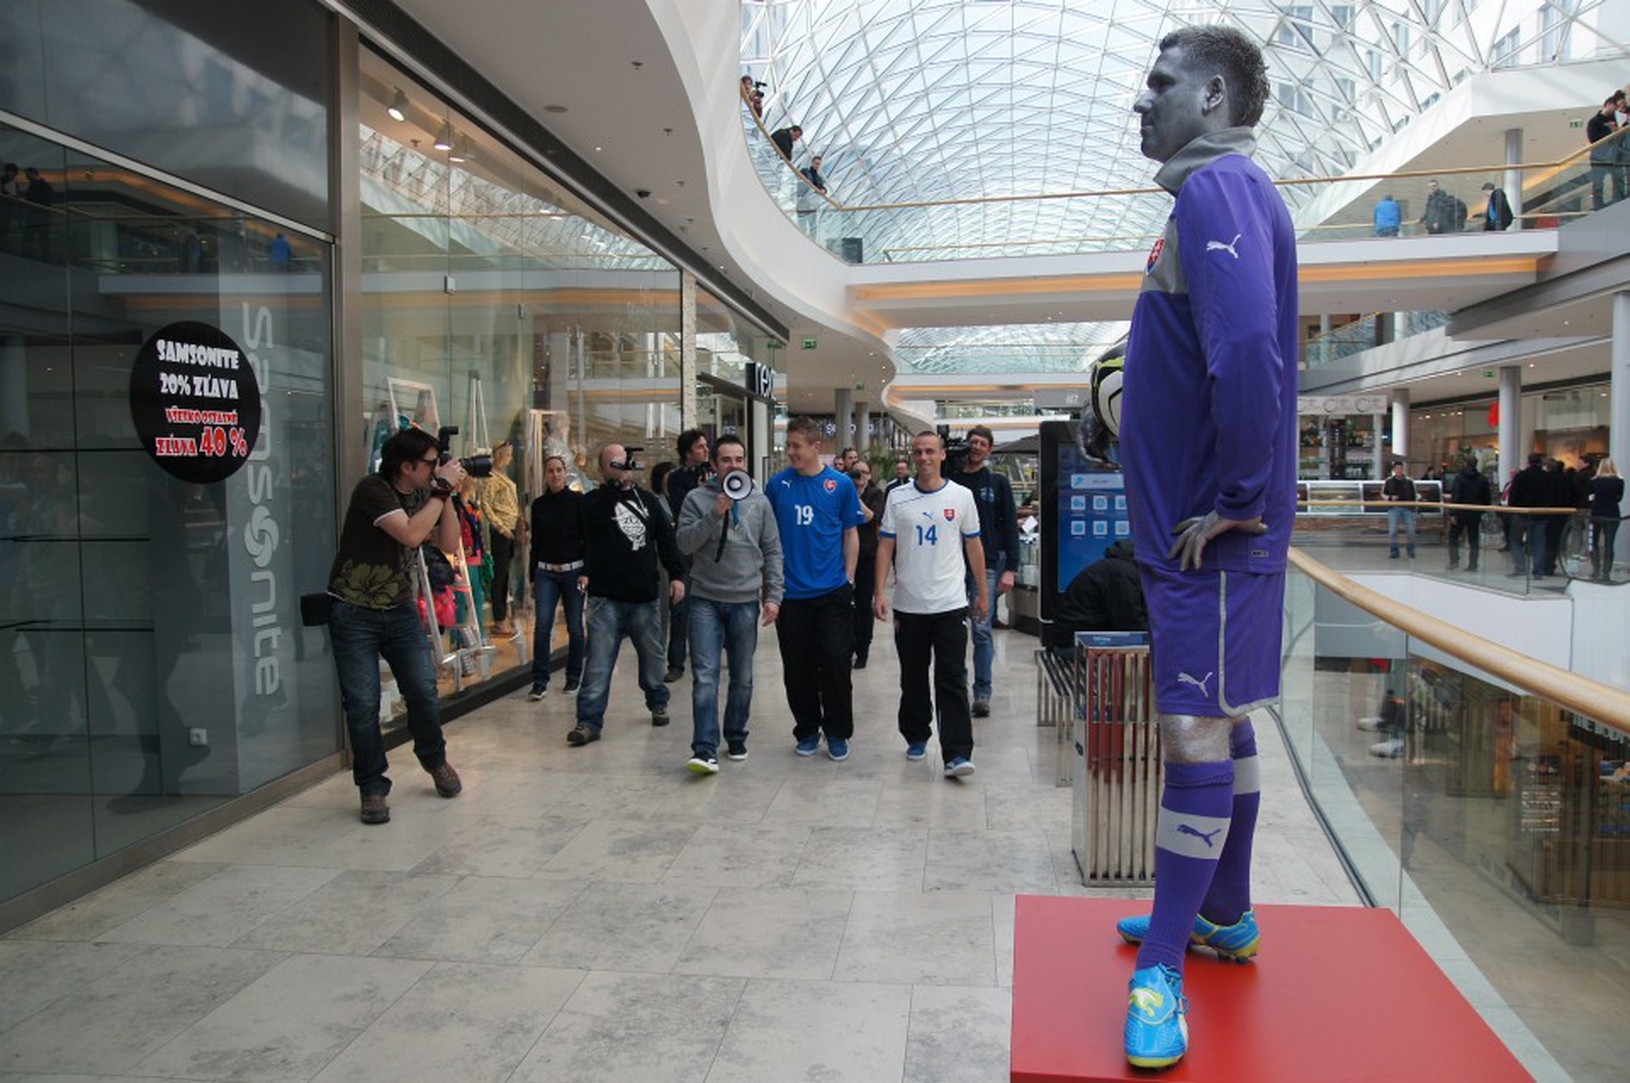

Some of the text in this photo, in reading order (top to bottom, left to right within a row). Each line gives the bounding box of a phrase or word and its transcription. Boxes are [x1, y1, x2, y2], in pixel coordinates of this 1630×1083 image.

[156, 339, 239, 369] SAMSONITE
[160, 372, 239, 399] 20% ZĽAVA
[155, 433, 198, 456] ZĽAVA
[794, 504, 814, 526] 19
[916, 524, 938, 546] 14
